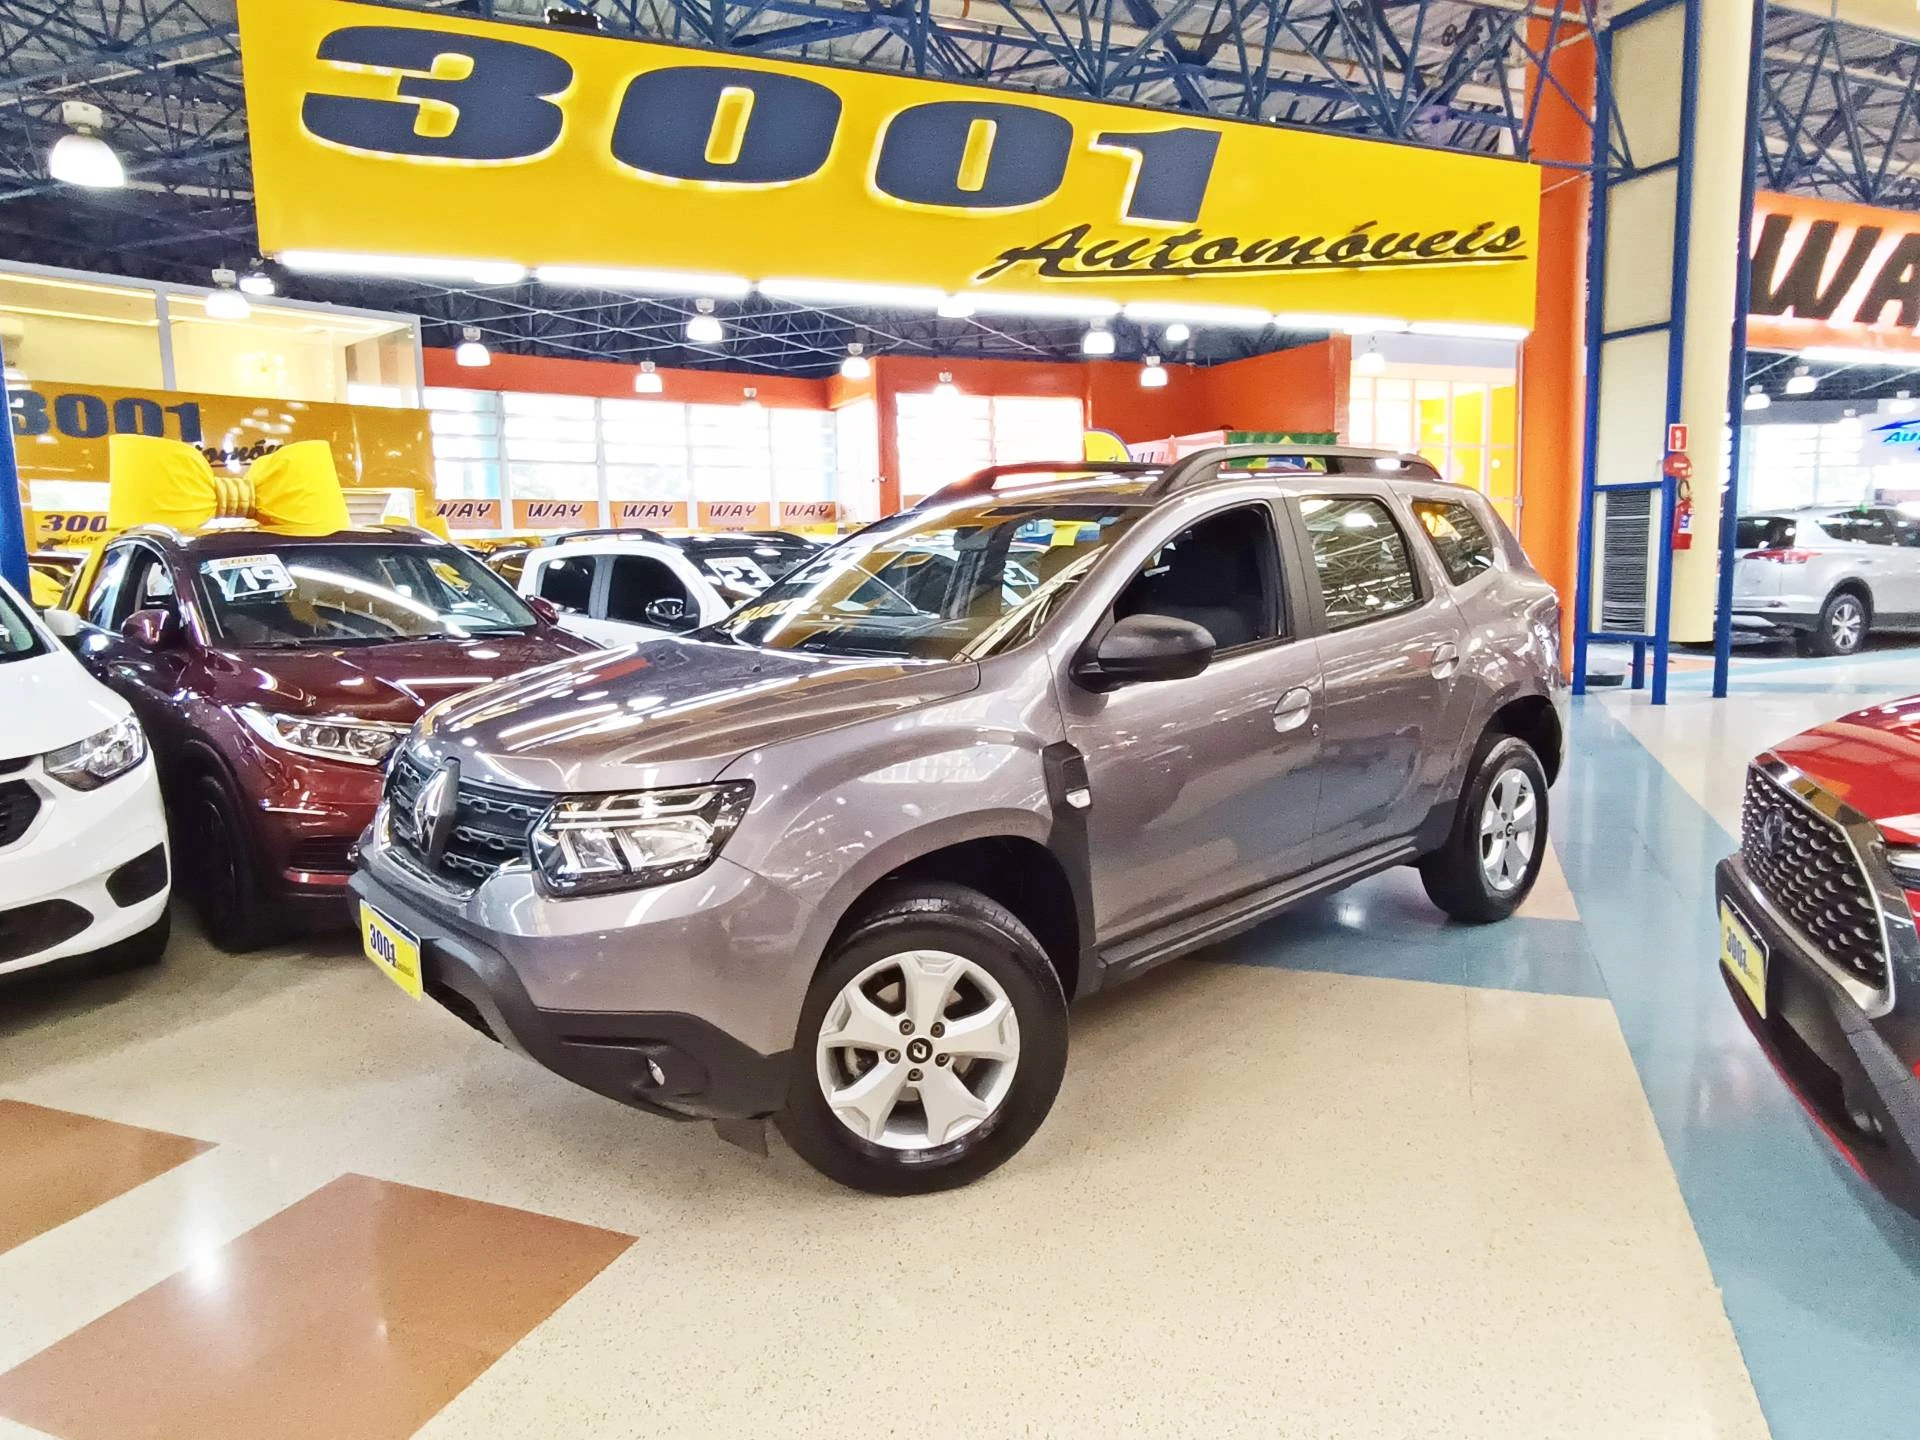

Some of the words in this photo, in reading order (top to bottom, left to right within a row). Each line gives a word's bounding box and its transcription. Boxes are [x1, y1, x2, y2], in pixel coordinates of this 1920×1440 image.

[302, 25, 1222, 224] 3001
[977, 221, 1528, 280] Automóveis
[10, 390, 202, 442] 3001
[1882, 431, 1920, 442] Au
[528, 504, 583, 517] WAY
[623, 504, 673, 517] WAY
[710, 504, 756, 517] WAY
[785, 504, 829, 517] WAY
[369, 923, 396, 968] 3001
